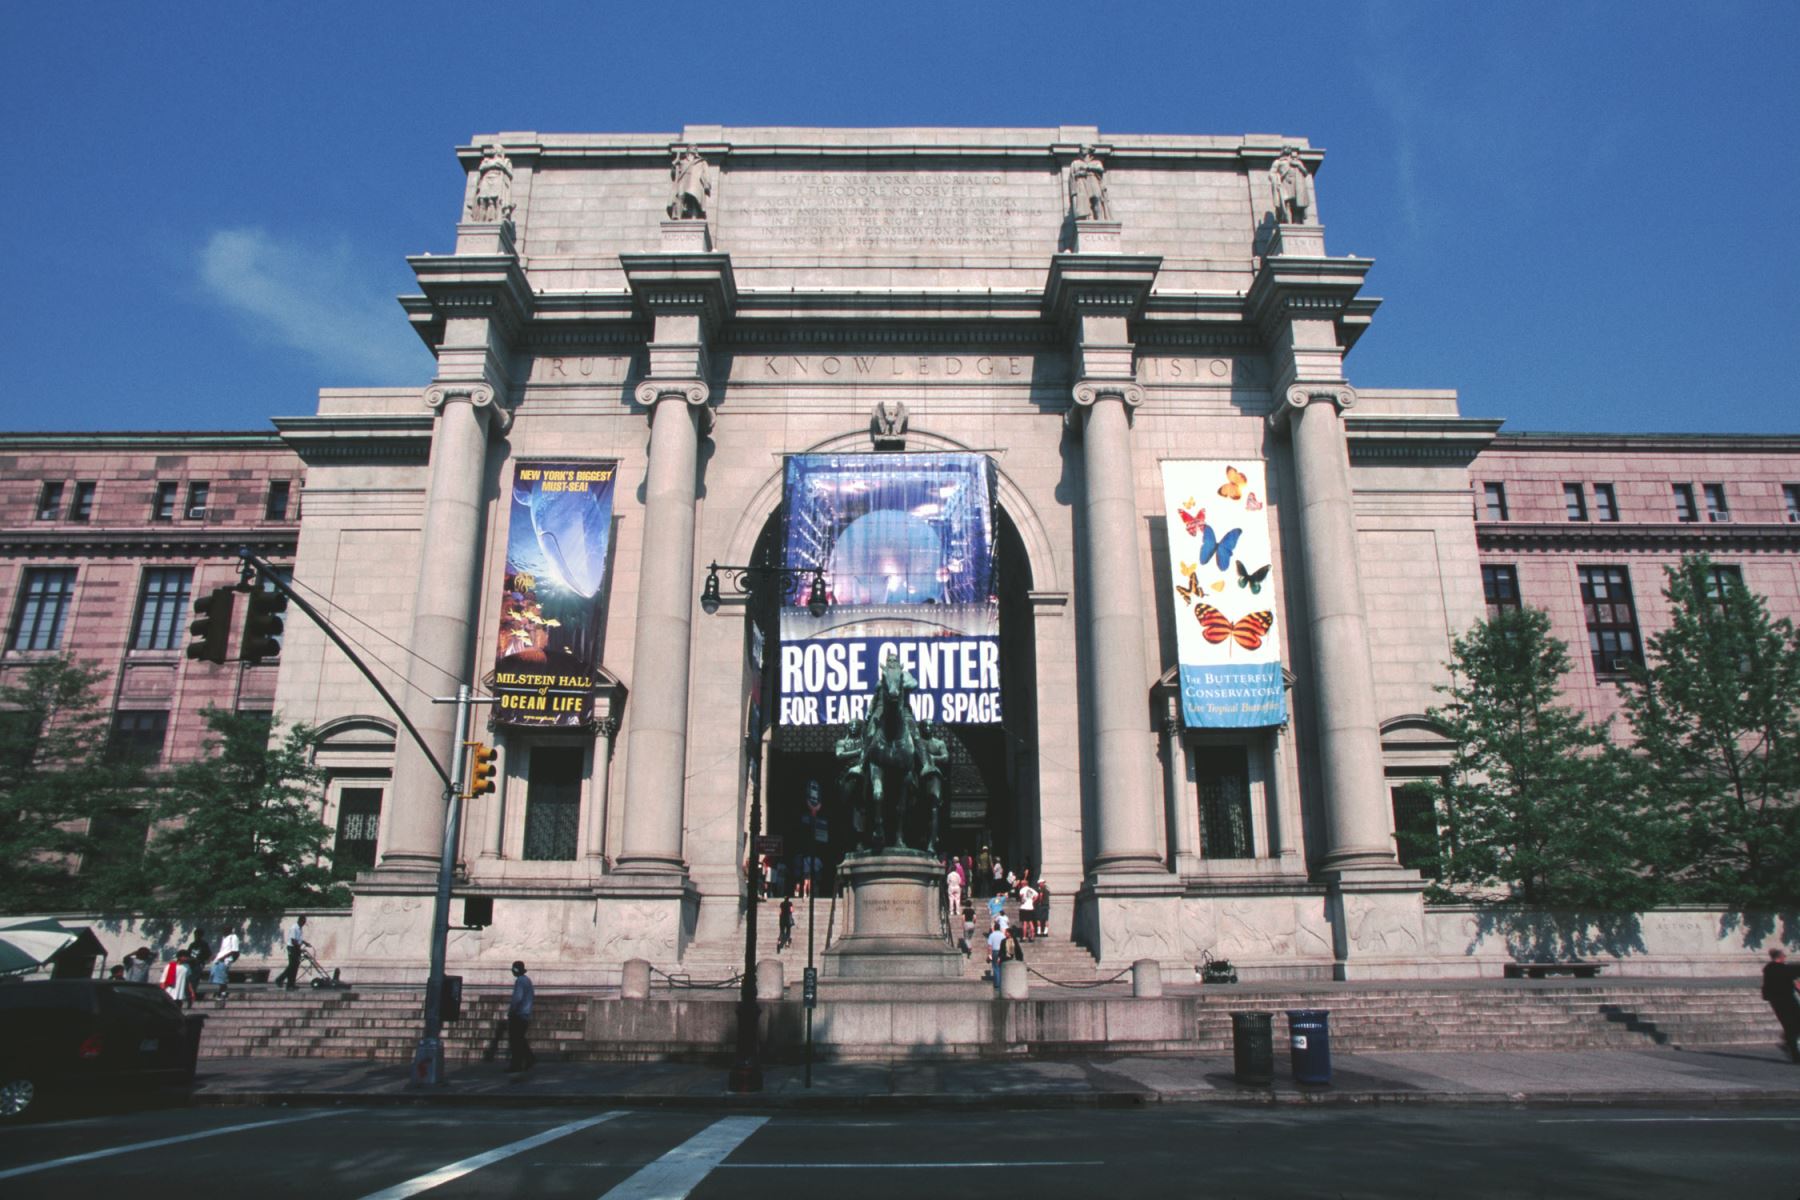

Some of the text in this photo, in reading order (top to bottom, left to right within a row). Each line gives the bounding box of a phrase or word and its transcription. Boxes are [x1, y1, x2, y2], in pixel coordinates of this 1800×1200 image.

[781, 175, 1001, 185] STATE OF NEW YORK MEMORIAL TO
[806, 186, 975, 197] THEODORE ROOSEVELT
[866, 227, 951, 235] CONSERVATION
[551, 357, 640, 377] RUT
[764, 356, 1021, 376] KNOWLEDGE
[520, 470, 612, 481] NEW YORK'S BIGGEST
[542, 481, 588, 492] MUST-SEA!
[780, 641, 1000, 693] ROSE CENTER
[496, 673, 592, 687] MILSTEIN HALL
[1205, 673, 1273, 684] BUTTERFLY
[538, 687, 549, 696] of
[1185, 686, 1280, 698] CONSERVATORY
[501, 695, 583, 712] OCEAN LIFE
[779, 692, 1002, 726] FOR EART ND SPACE
[1207, 703, 1238, 715] Tropical
